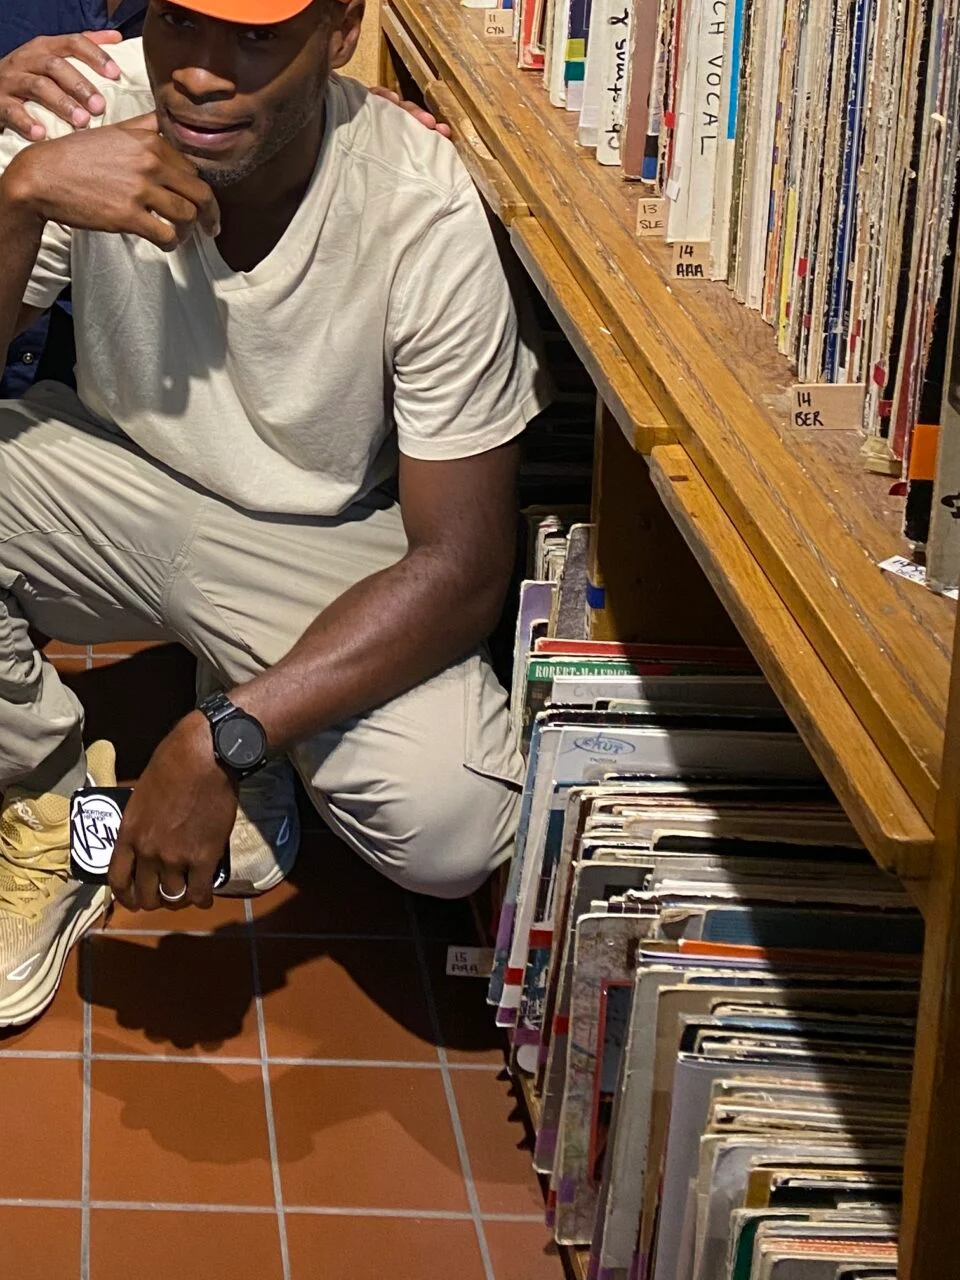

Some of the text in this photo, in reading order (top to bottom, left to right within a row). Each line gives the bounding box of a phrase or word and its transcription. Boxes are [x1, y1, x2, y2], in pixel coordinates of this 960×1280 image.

[486, 26, 505, 35] CYN
[700, 54, 725, 156] VOCAL
[642, 203, 658, 214] 13
[639, 219, 665, 230] SLE
[678, 244, 695, 259] 14
[675, 262, 705, 278] AAA
[796, 391, 812, 408] 14
[794, 409, 825, 428] BER
